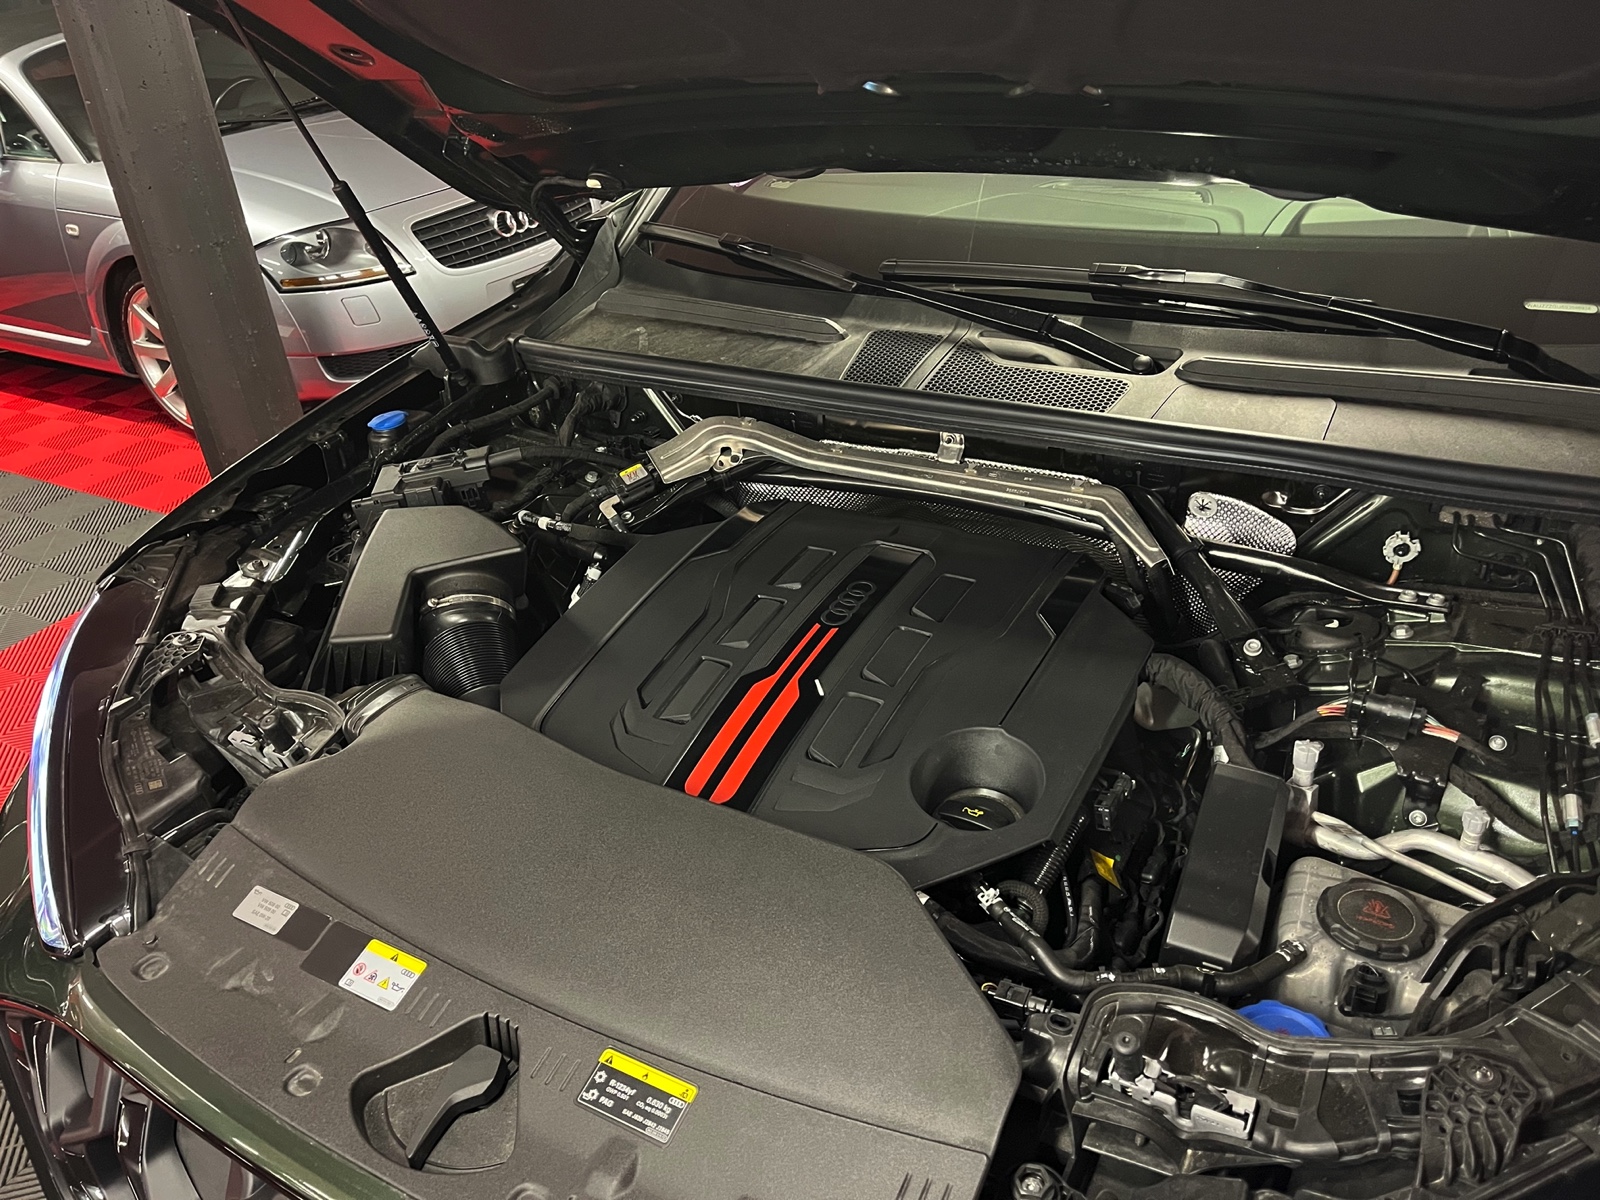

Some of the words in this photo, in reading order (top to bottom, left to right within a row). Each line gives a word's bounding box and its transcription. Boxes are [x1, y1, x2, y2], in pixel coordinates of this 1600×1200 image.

[608, 1079, 637, 1096] R-1234yf
[598, 1096, 615, 1108] PAG
[663, 1102, 673, 1114] kg
[621, 1108, 634, 1117] SAE
